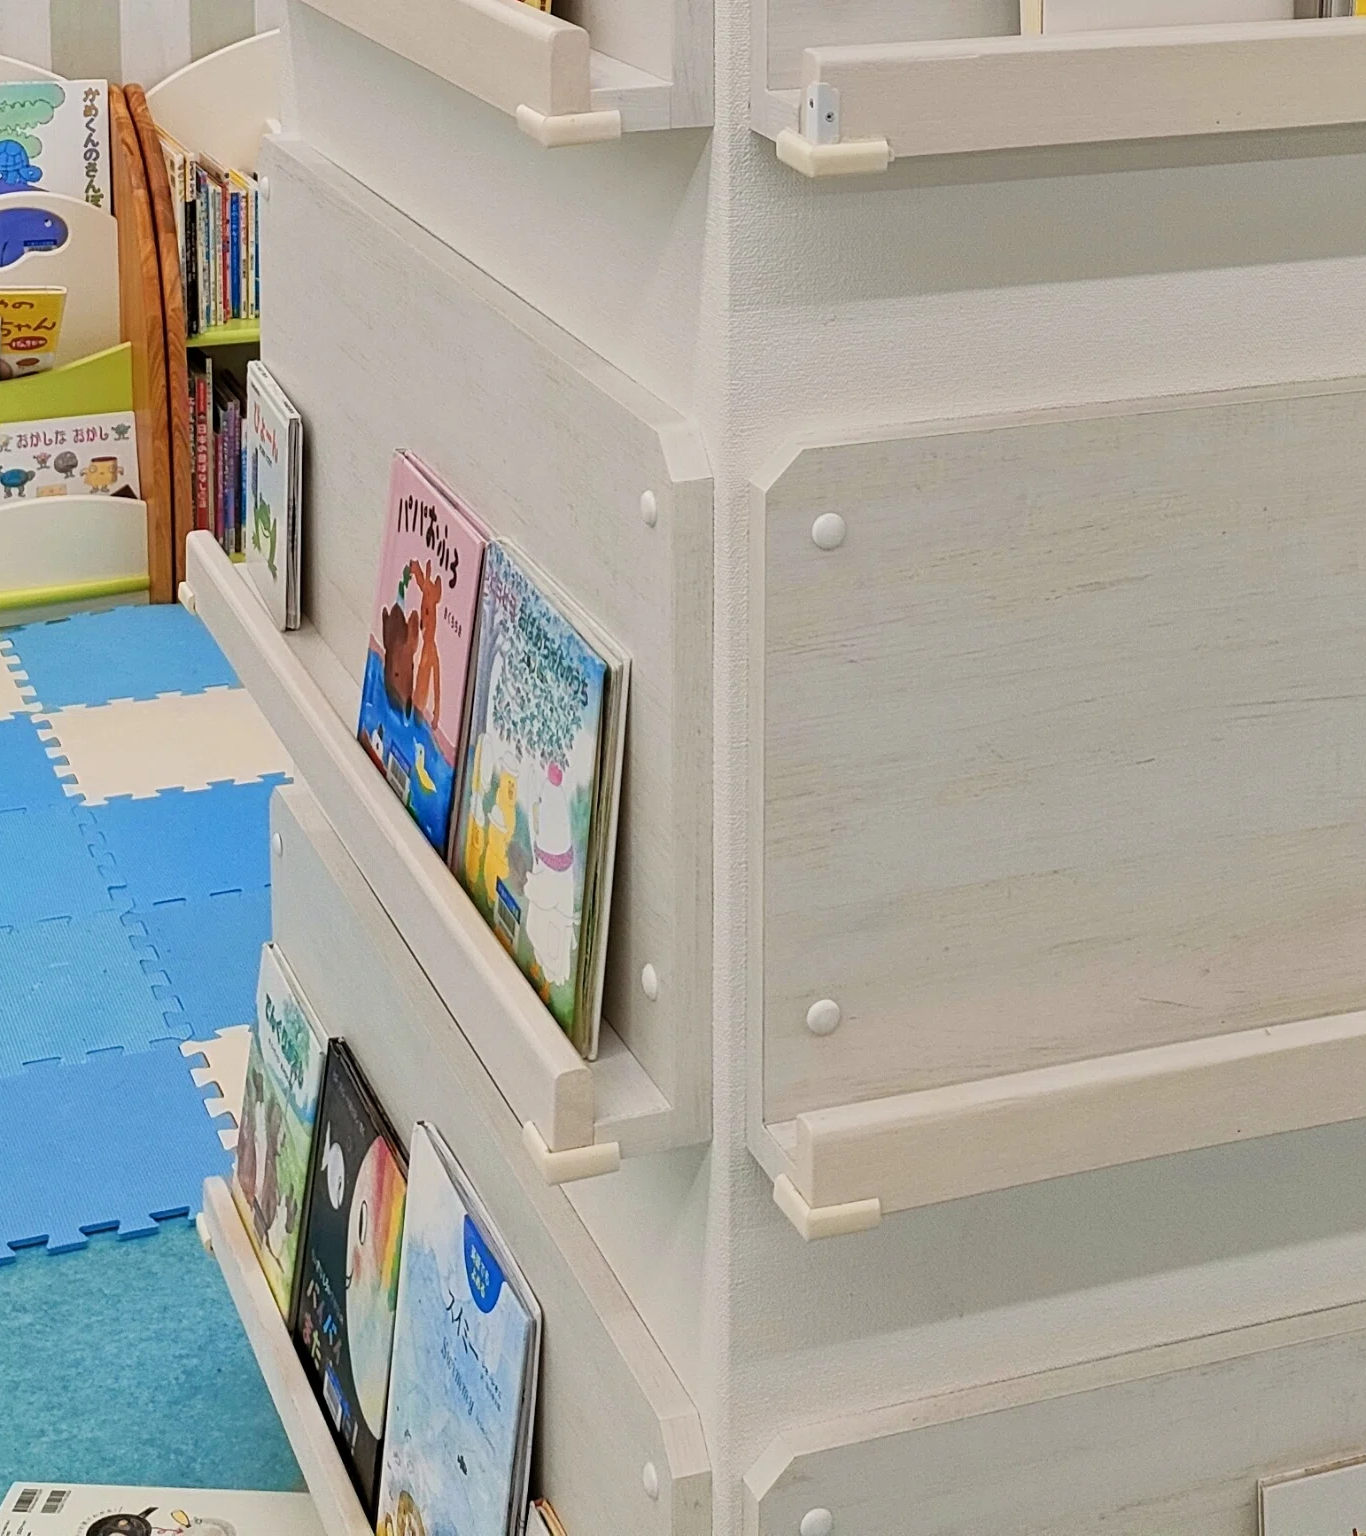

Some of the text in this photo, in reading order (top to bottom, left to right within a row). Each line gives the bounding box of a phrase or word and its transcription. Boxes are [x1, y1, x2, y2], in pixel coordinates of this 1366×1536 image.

[15, 425, 110, 450] おかしな おかし
[397, 494, 459, 590] パパおふろ
[445, 1288, 479, 1362] スイミー
